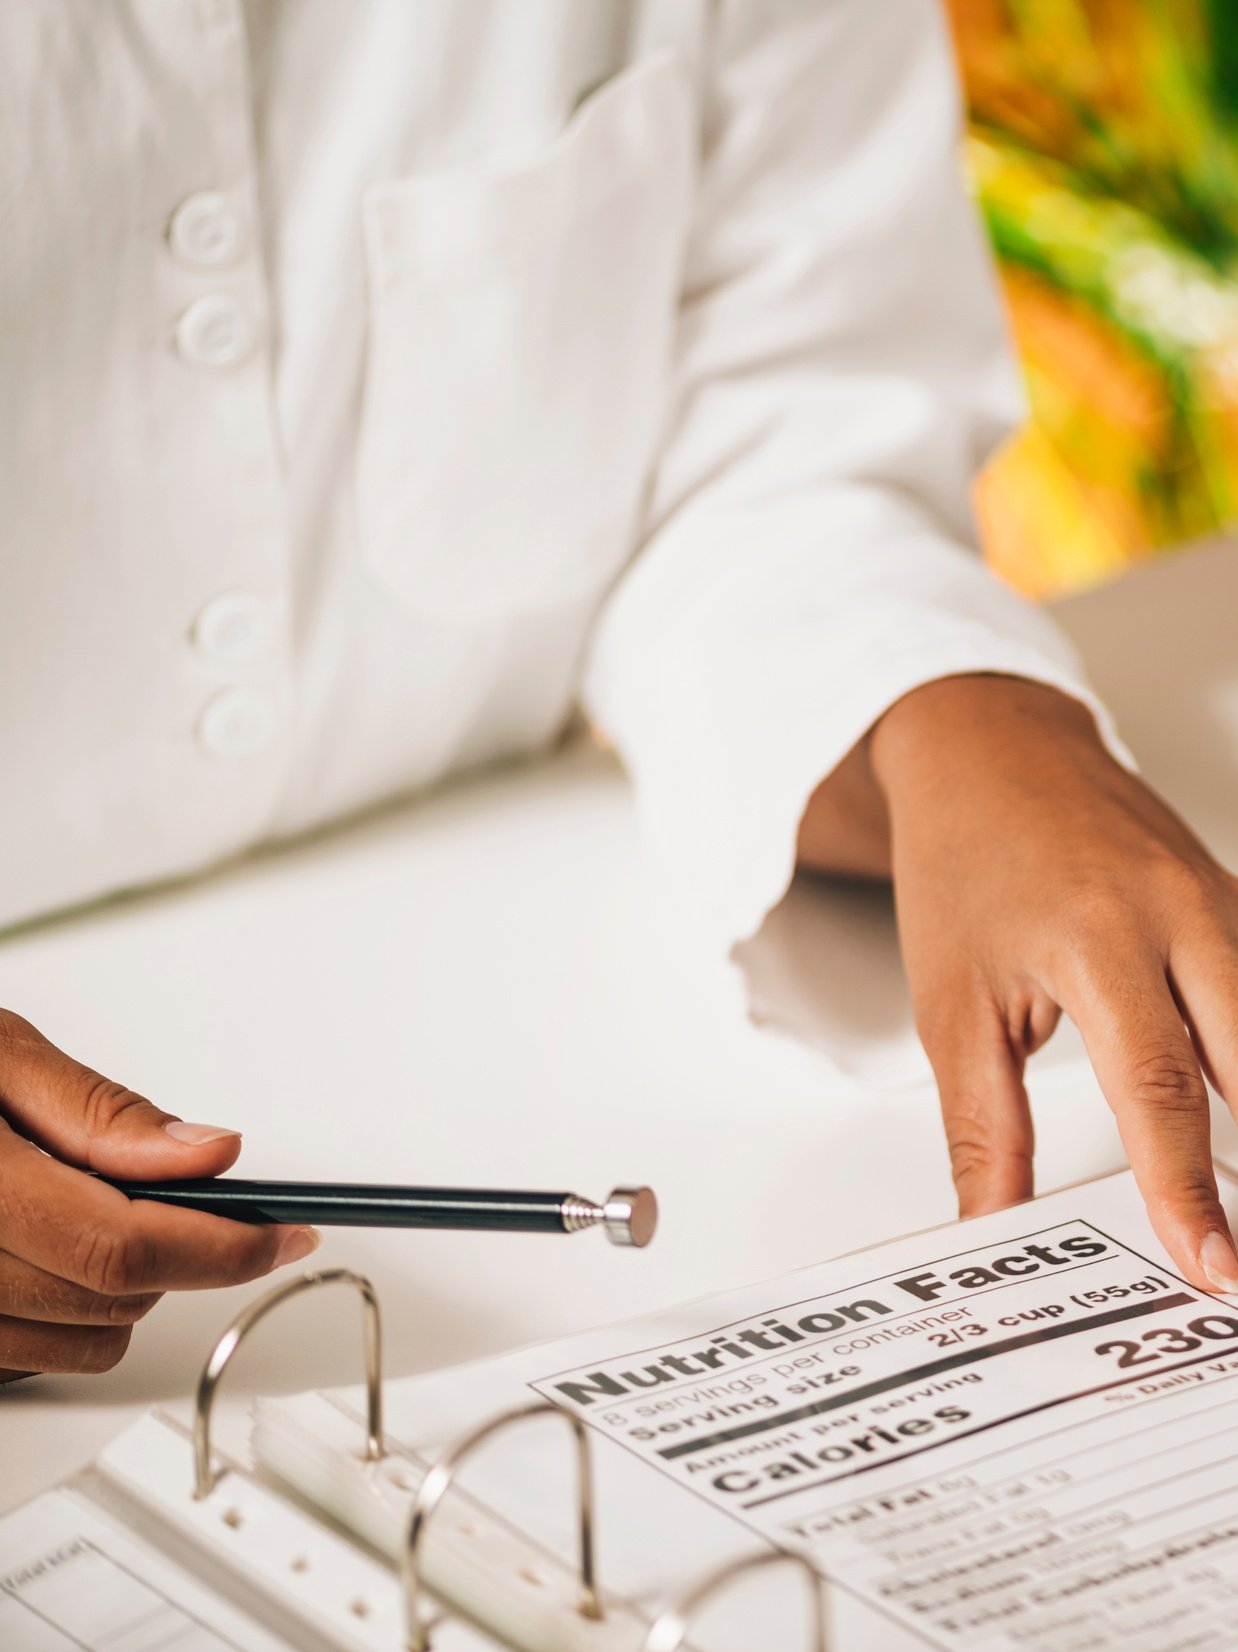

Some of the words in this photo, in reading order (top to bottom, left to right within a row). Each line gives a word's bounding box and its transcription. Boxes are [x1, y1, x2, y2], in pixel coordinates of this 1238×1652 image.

[553, 1299, 893, 1405] Nutrition
[893, 1237, 1107, 1301] Facts
[602, 1412, 628, 1426] 8
[635, 1373, 768, 1416] servings
[772, 1351, 825, 1378] per
[832, 1305, 973, 1355] container
[628, 1394, 779, 1440] Serving
[787, 1364, 862, 1395] size
[927, 1323, 988, 1347] 2/3
[997, 1303, 1065, 1326] cup
[1069, 1276, 1169, 1308] (55g)
[685, 1432, 802, 1474] Amount
[811, 1413, 860, 1435] per
[871, 1372, 983, 1415] serving
[1137, 1371, 1205, 1395] Daily
[712, 1404, 972, 1494] Calories
